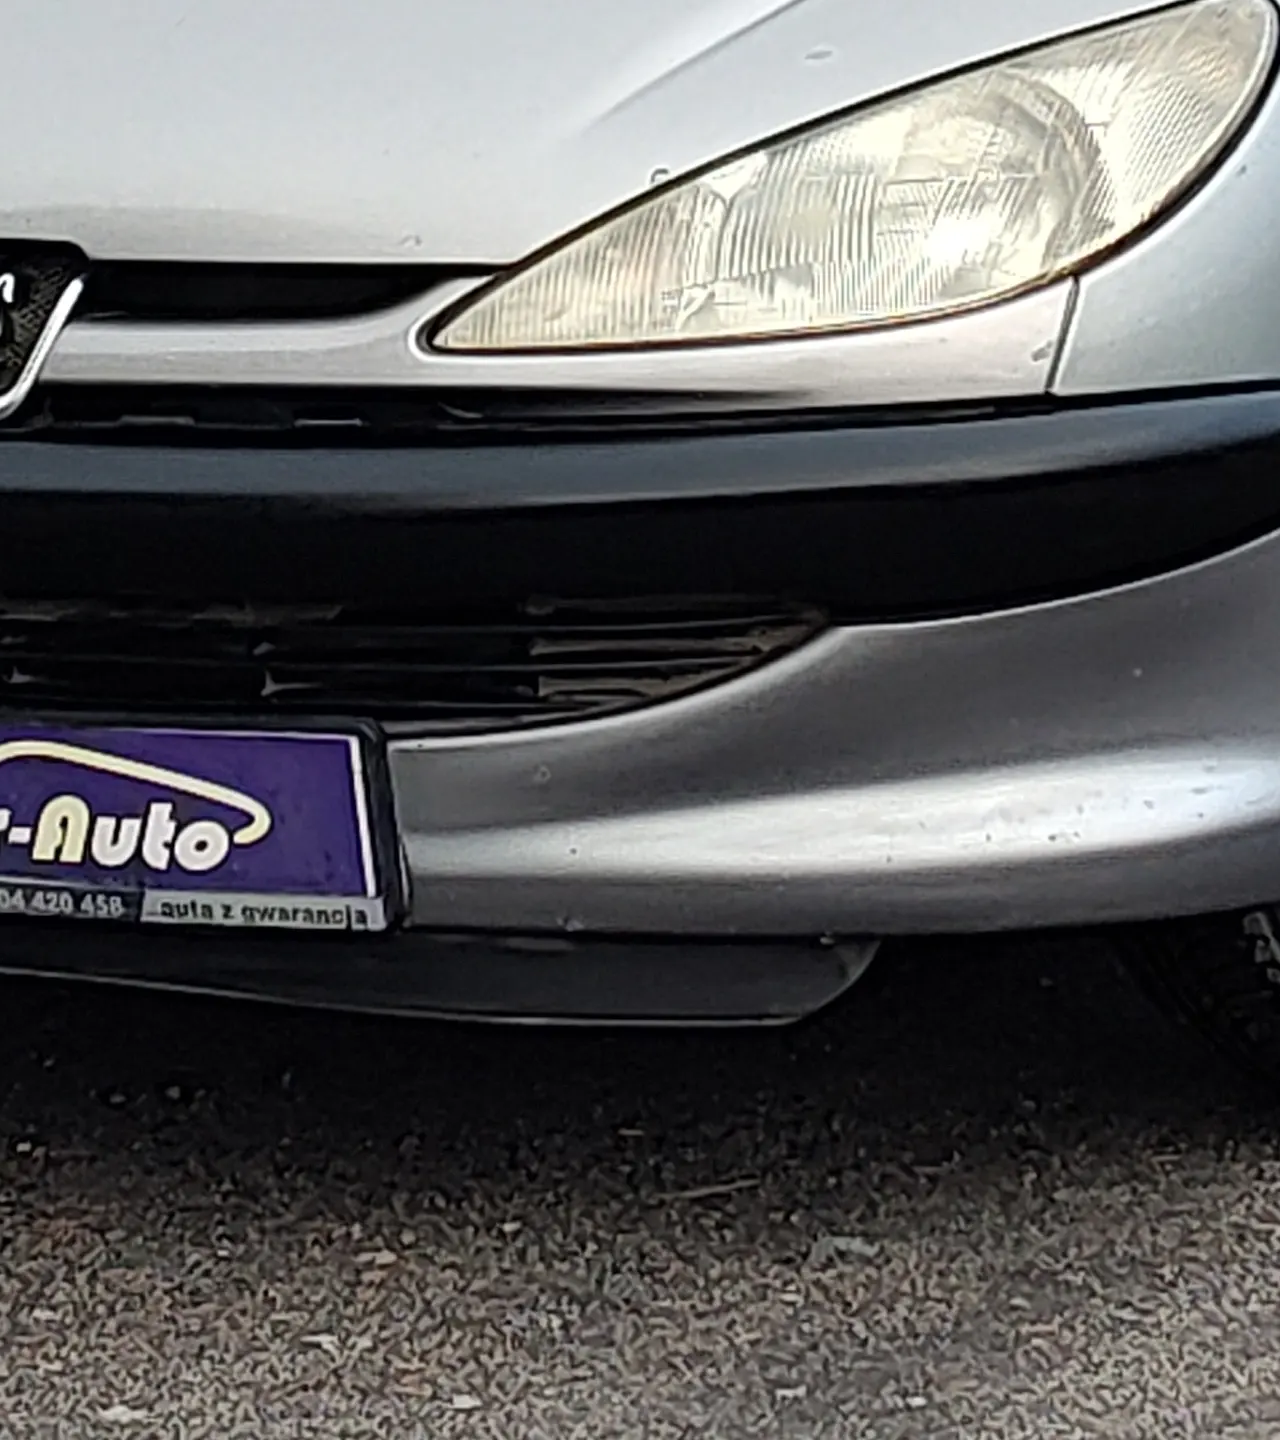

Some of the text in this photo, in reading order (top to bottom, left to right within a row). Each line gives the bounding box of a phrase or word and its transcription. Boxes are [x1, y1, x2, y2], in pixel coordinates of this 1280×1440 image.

[30, 890, 74, 915] 420
[159, 899, 214, 920] auta
[221, 902, 236, 920] z
